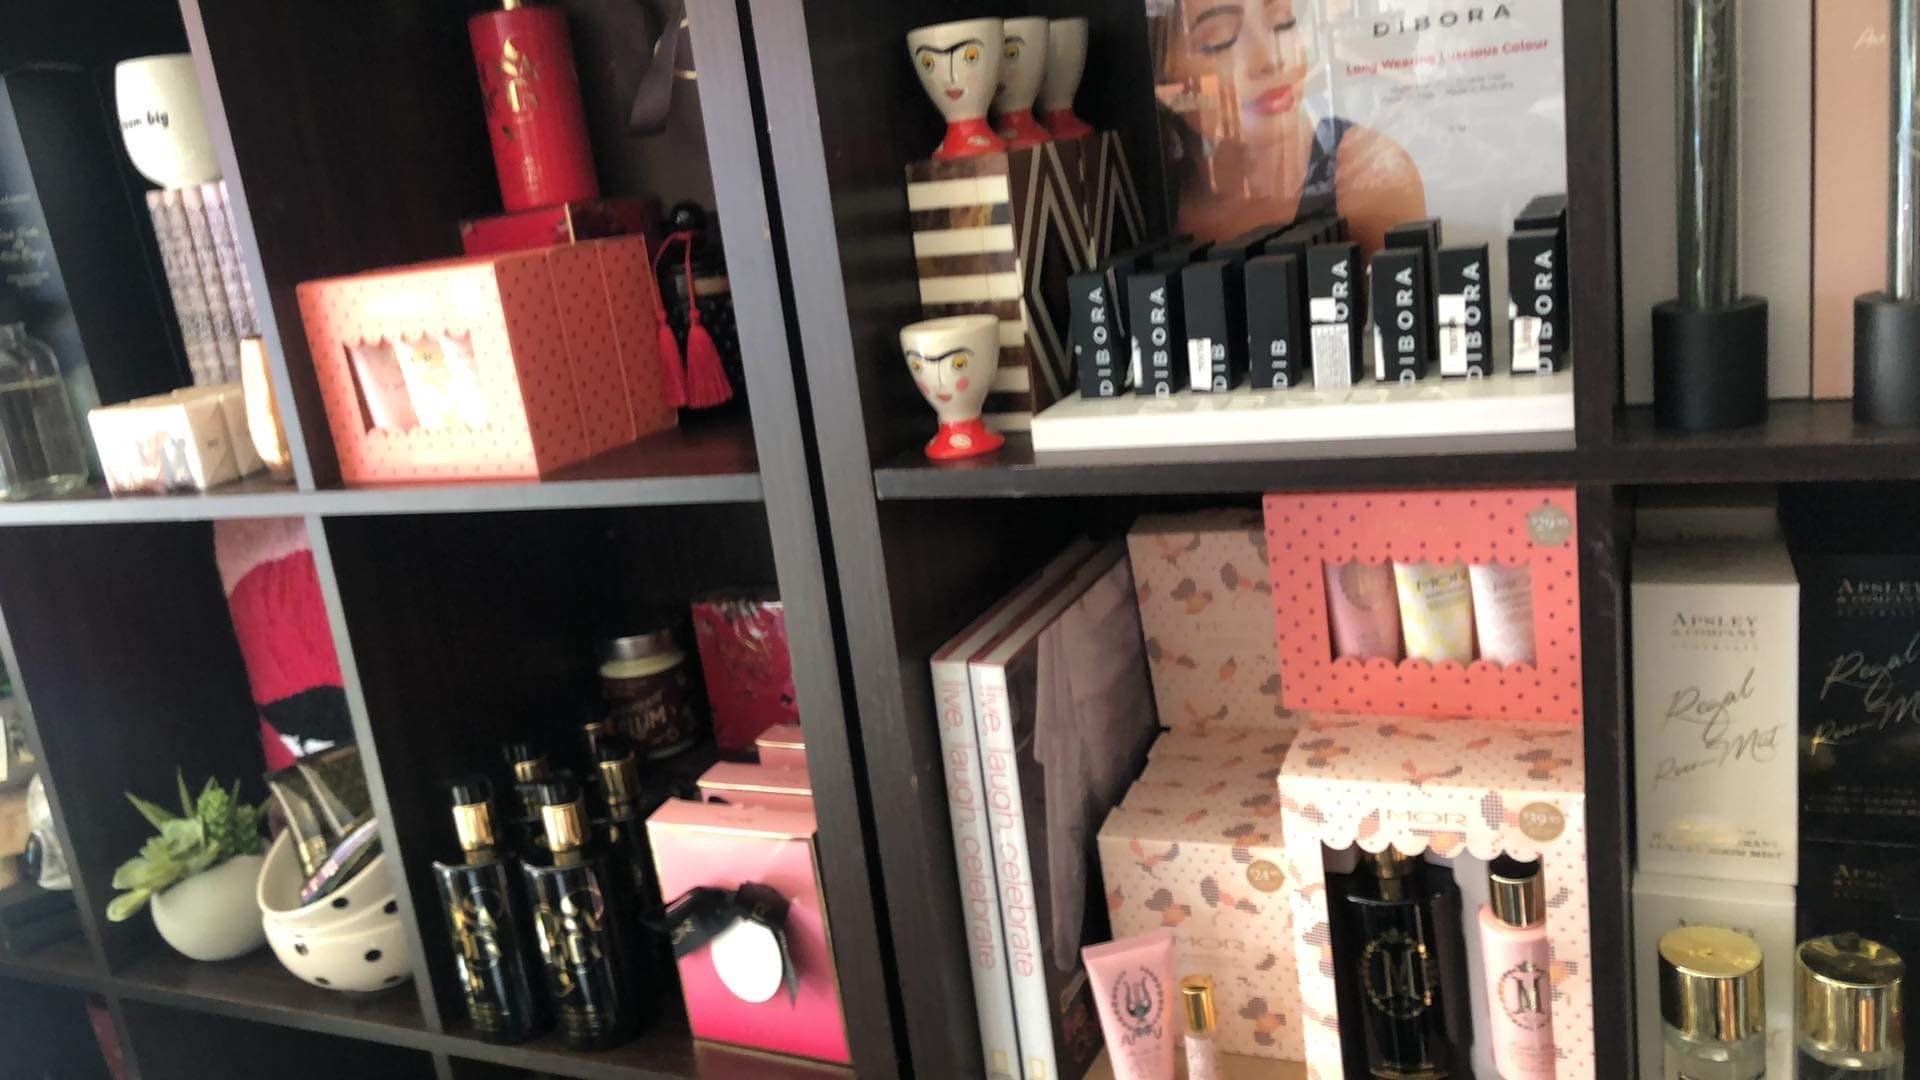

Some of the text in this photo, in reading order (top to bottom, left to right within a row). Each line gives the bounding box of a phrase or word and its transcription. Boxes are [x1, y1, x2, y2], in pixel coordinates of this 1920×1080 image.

[1346, 38, 1549, 77] Long Wearing Lscious Colour
[1373, 4, 1511, 38] DIBORA
[146, 110, 169, 129] big
[1089, 286, 1114, 396] DIBORA
[1150, 286, 1171, 399] DIBORA
[1330, 259, 1350, 323] ORA
[1395, 265, 1416, 384] DIBORA
[1462, 260, 1484, 380] DIBORA
[1533, 249, 1553, 375] DIBORA
[1672, 611, 1759, 627] APSLEY
[960, 836, 998, 971] celebrate
[1000, 842, 1035, 978] celebrate
